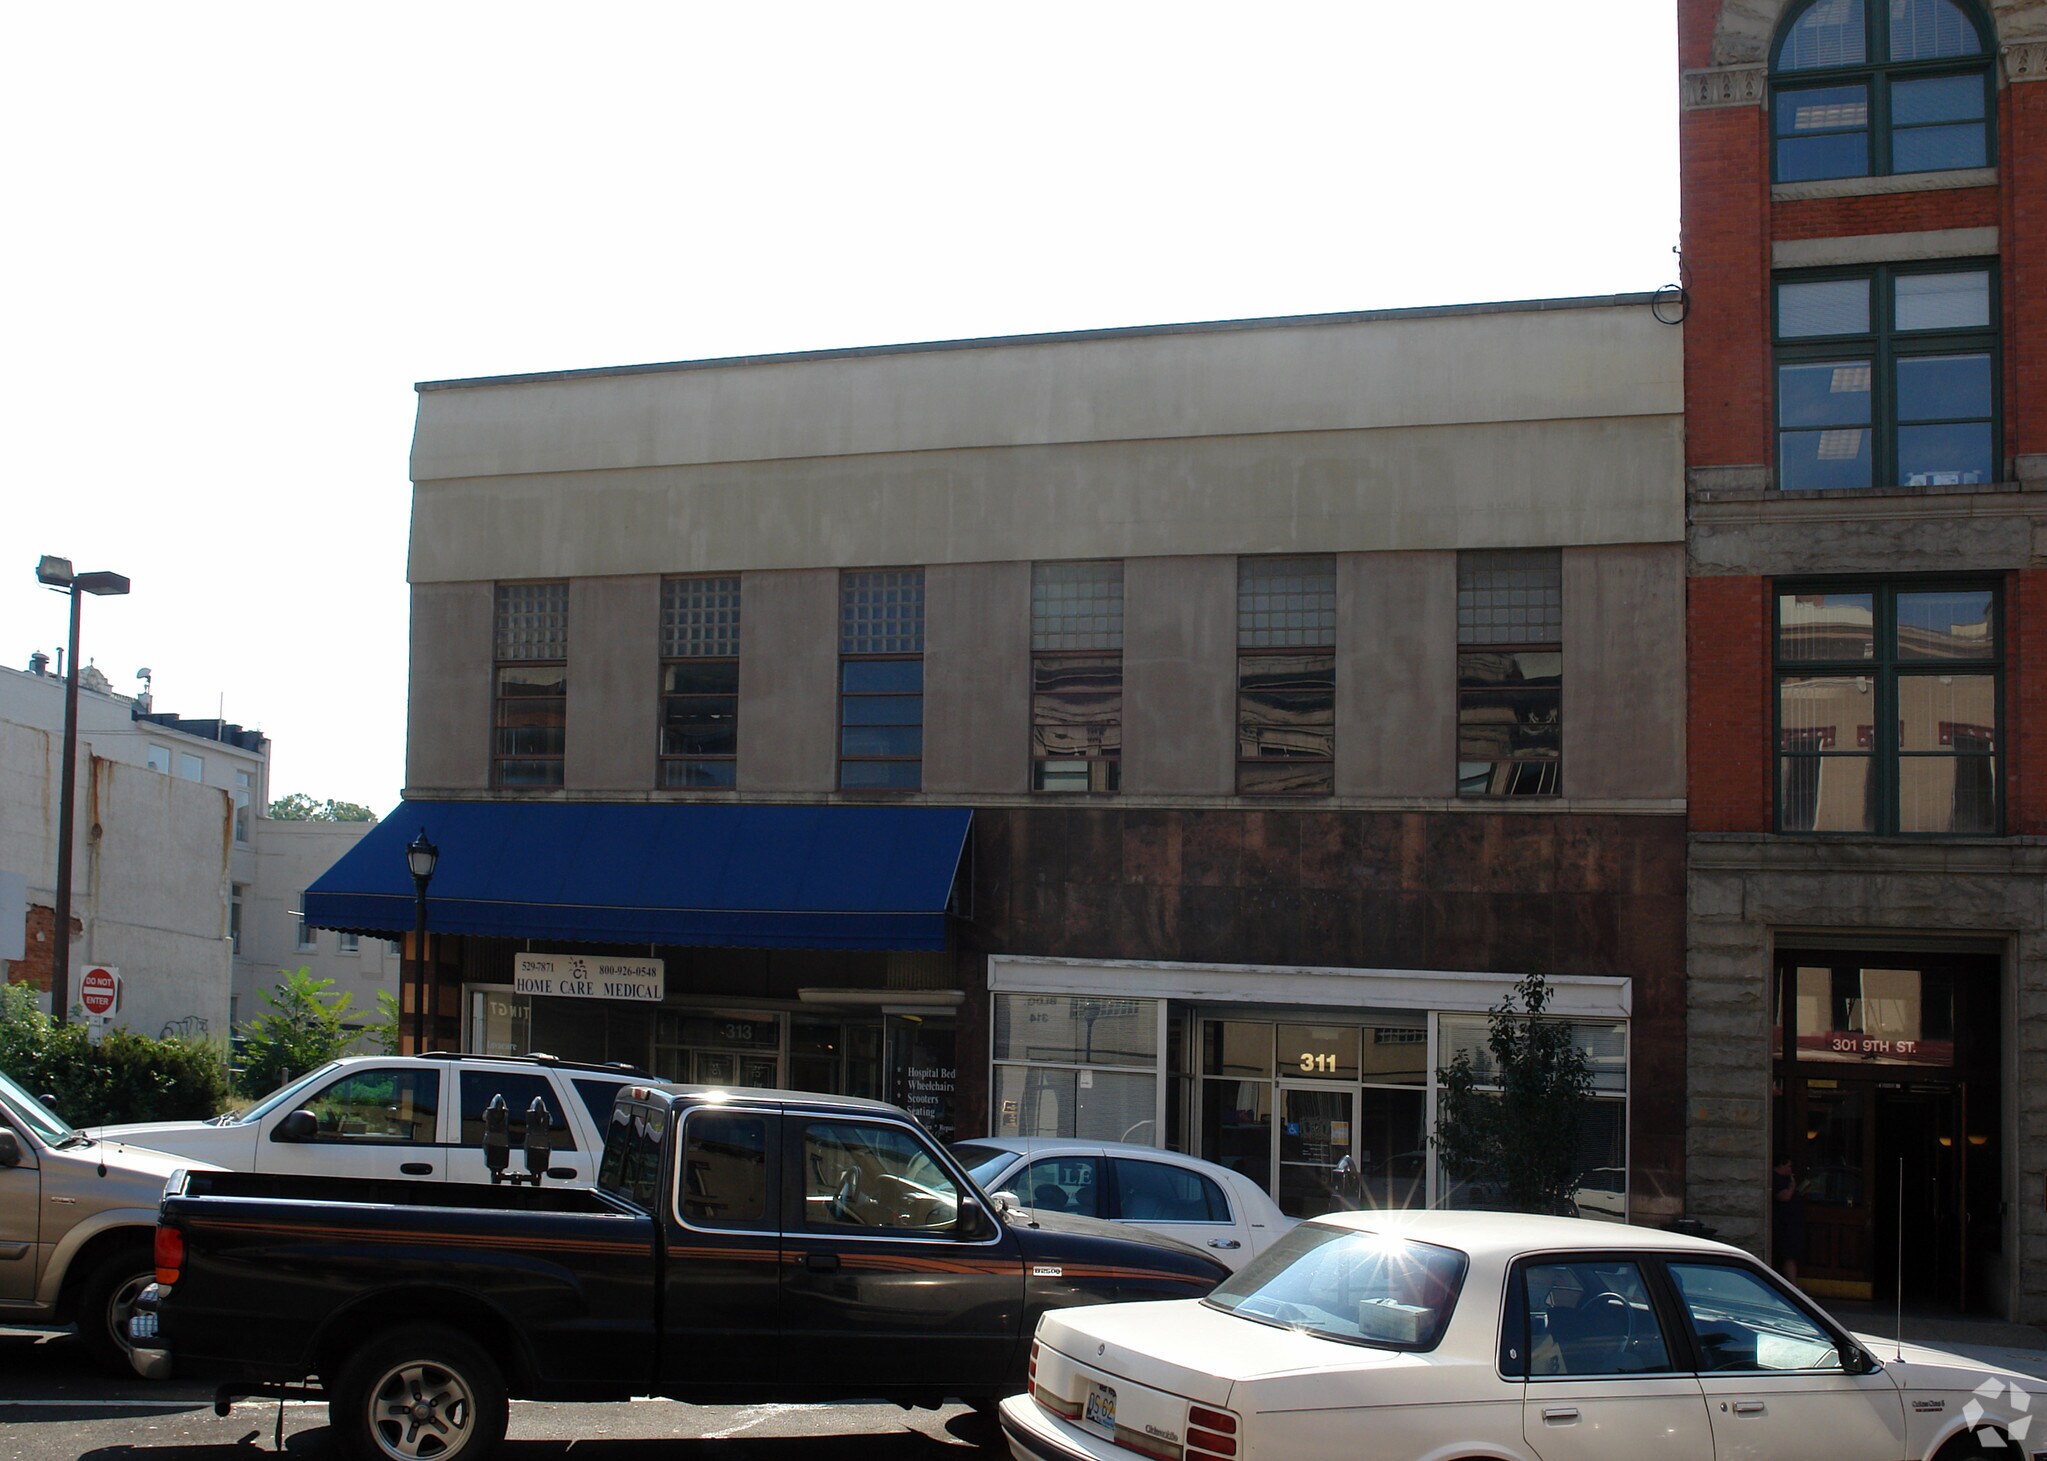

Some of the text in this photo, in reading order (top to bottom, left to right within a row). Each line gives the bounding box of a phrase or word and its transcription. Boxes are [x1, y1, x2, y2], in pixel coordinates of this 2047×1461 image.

[522, 961, 657, 977] 529-7871 800-926-0548
[86, 977, 112, 986] DO NOT
[516, 978, 661, 999] HOME CARE MEDICAL
[86, 996, 109, 1005] ENTER
[726, 1024, 752, 1040] 313
[1832, 1039, 1916, 1053] 301 9TH ST.
[1300, 1053, 1336, 1073] 311
[908, 1067, 956, 1080] Hospital Bed
[908, 1080, 954, 1091] Wheelchairs
[907, 1093, 939, 1104] Scooters
[907, 1106, 935, 1118] Seating
